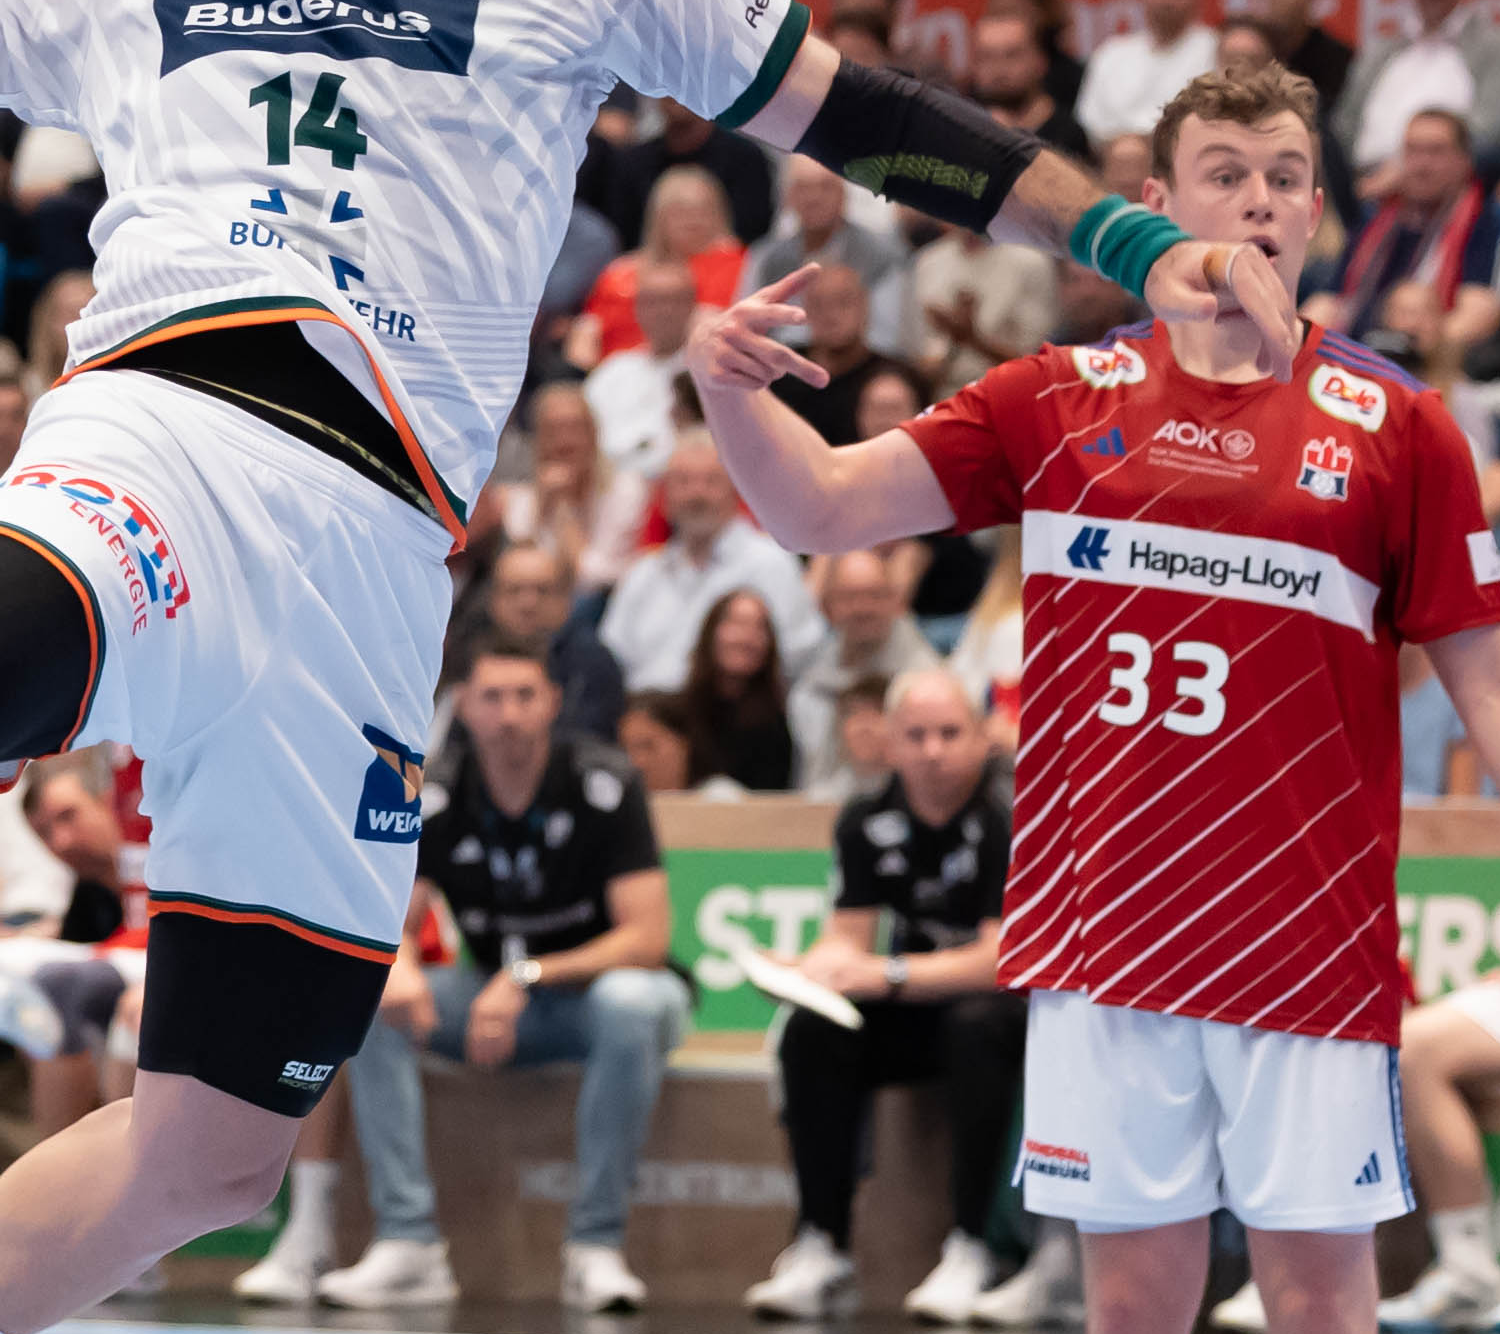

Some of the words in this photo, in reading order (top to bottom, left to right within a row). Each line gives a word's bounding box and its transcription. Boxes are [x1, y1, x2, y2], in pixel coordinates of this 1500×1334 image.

[249, 71, 368, 171] 14
[1323, 375, 1379, 411] Dole
[1152, 419, 1219, 454] AOK
[69, 500, 148, 637] ENERGIE
[1130, 540, 1322, 598] Hapag-Lloyd
[1098, 633, 1229, 735] 33
